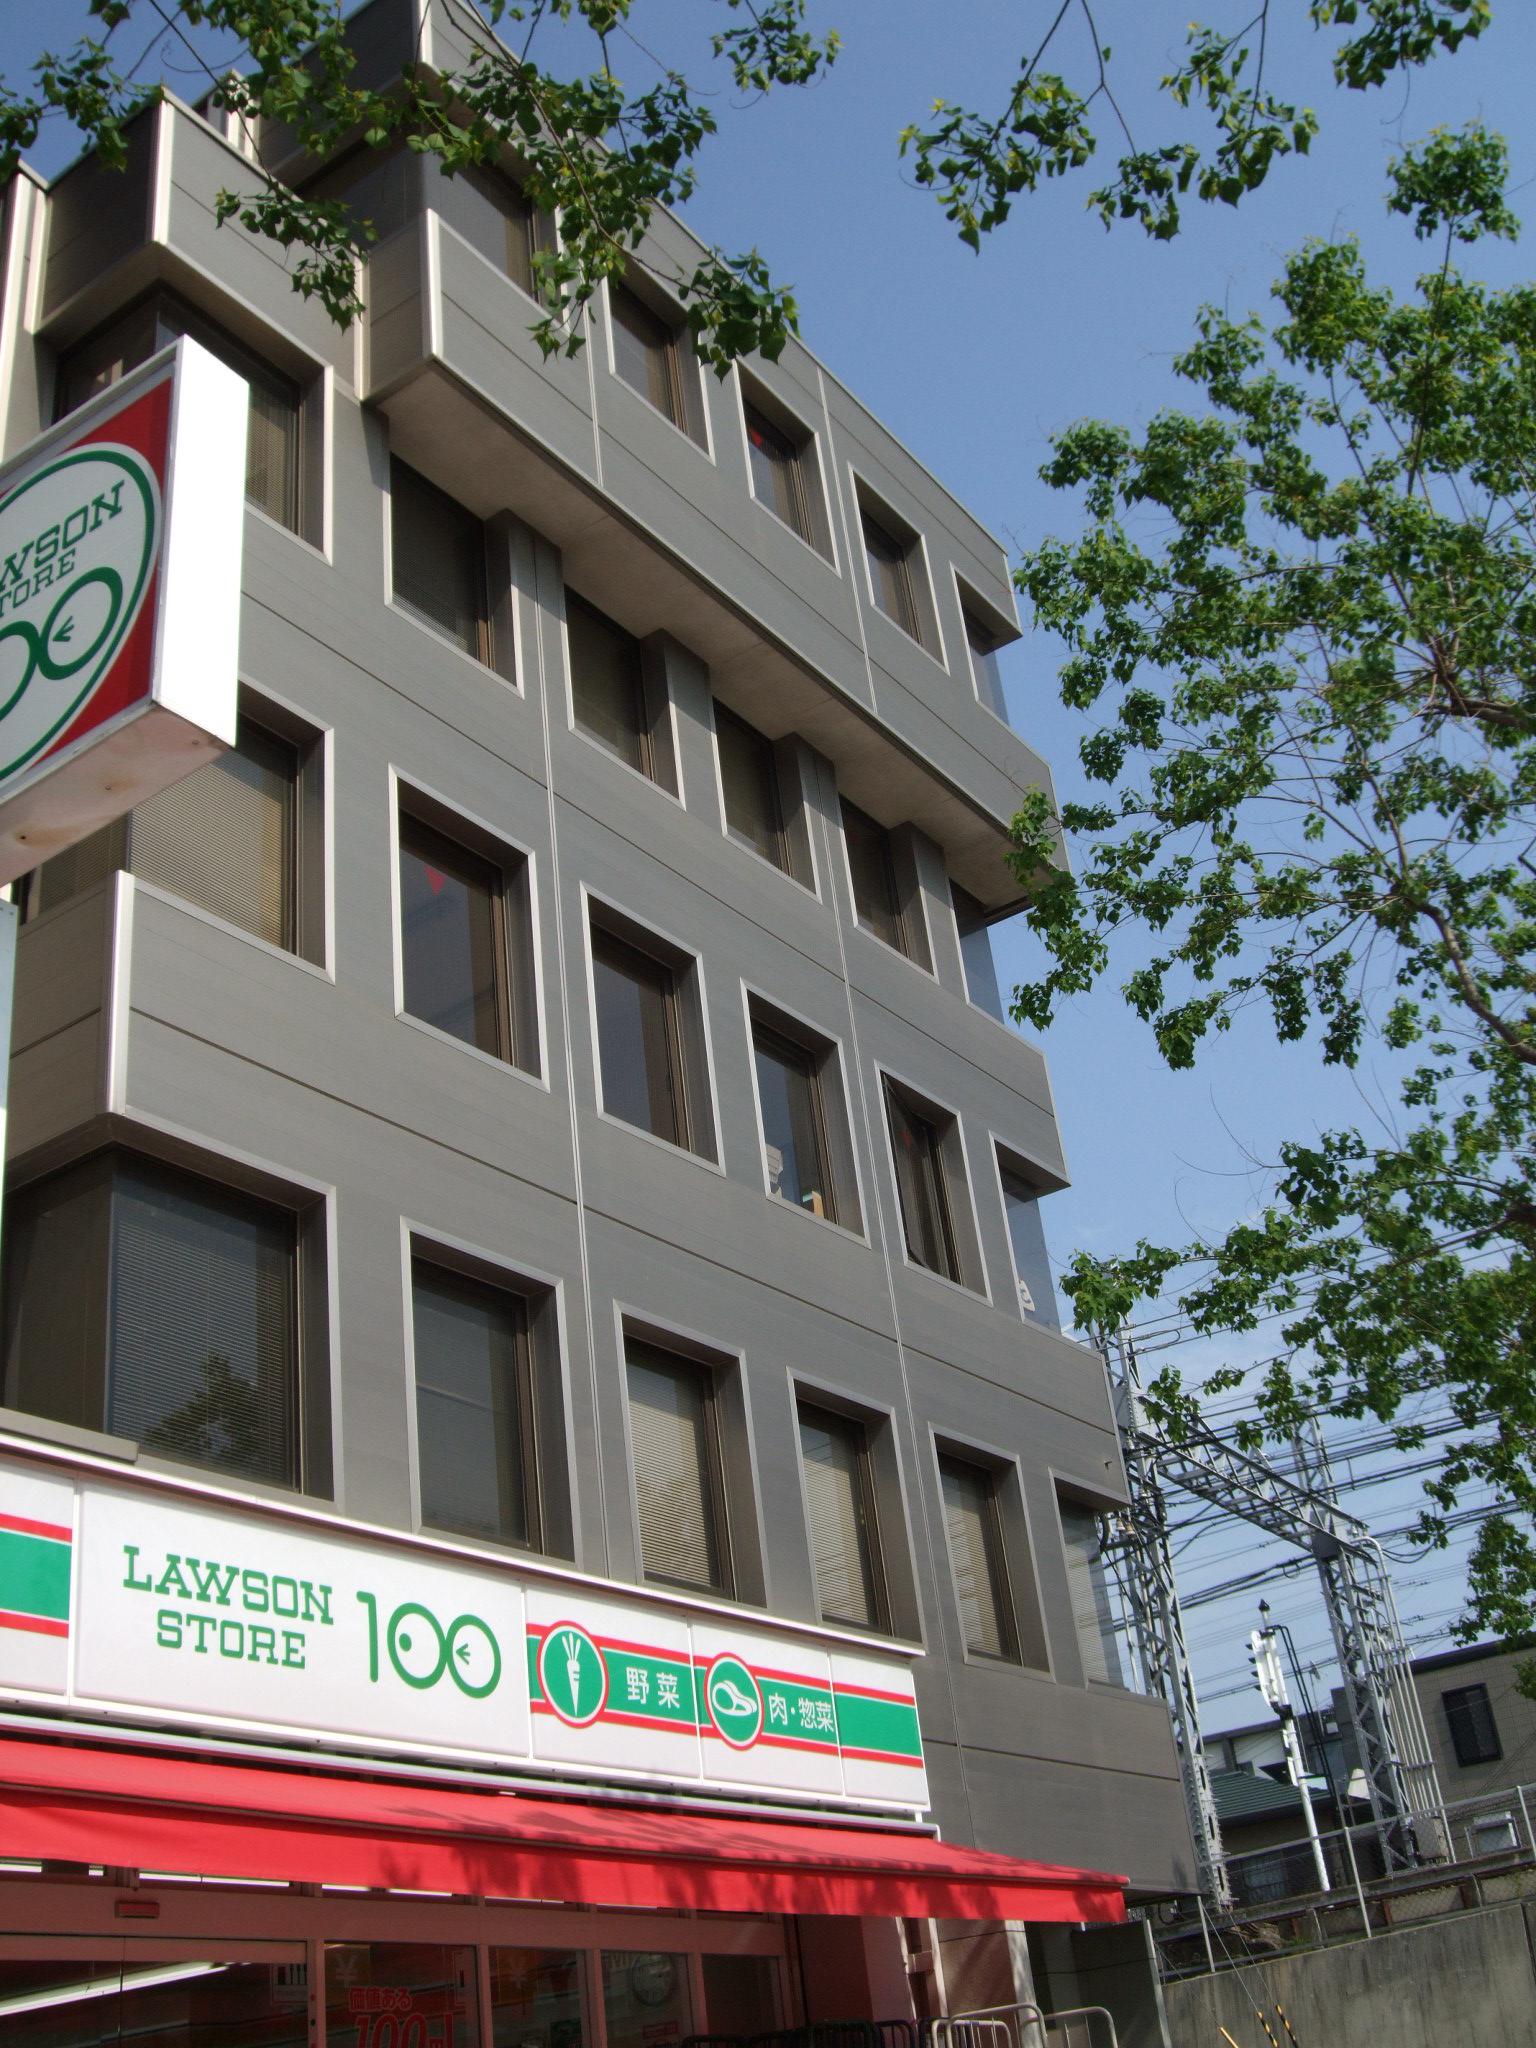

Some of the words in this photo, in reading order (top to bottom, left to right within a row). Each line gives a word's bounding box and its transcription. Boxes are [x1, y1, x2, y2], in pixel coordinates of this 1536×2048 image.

[123, 1544, 334, 1626] LAWSON
[156, 1608, 306, 1670] STORE
[356, 1590, 502, 1699] 100
[625, 1666, 681, 1710] 野菜
